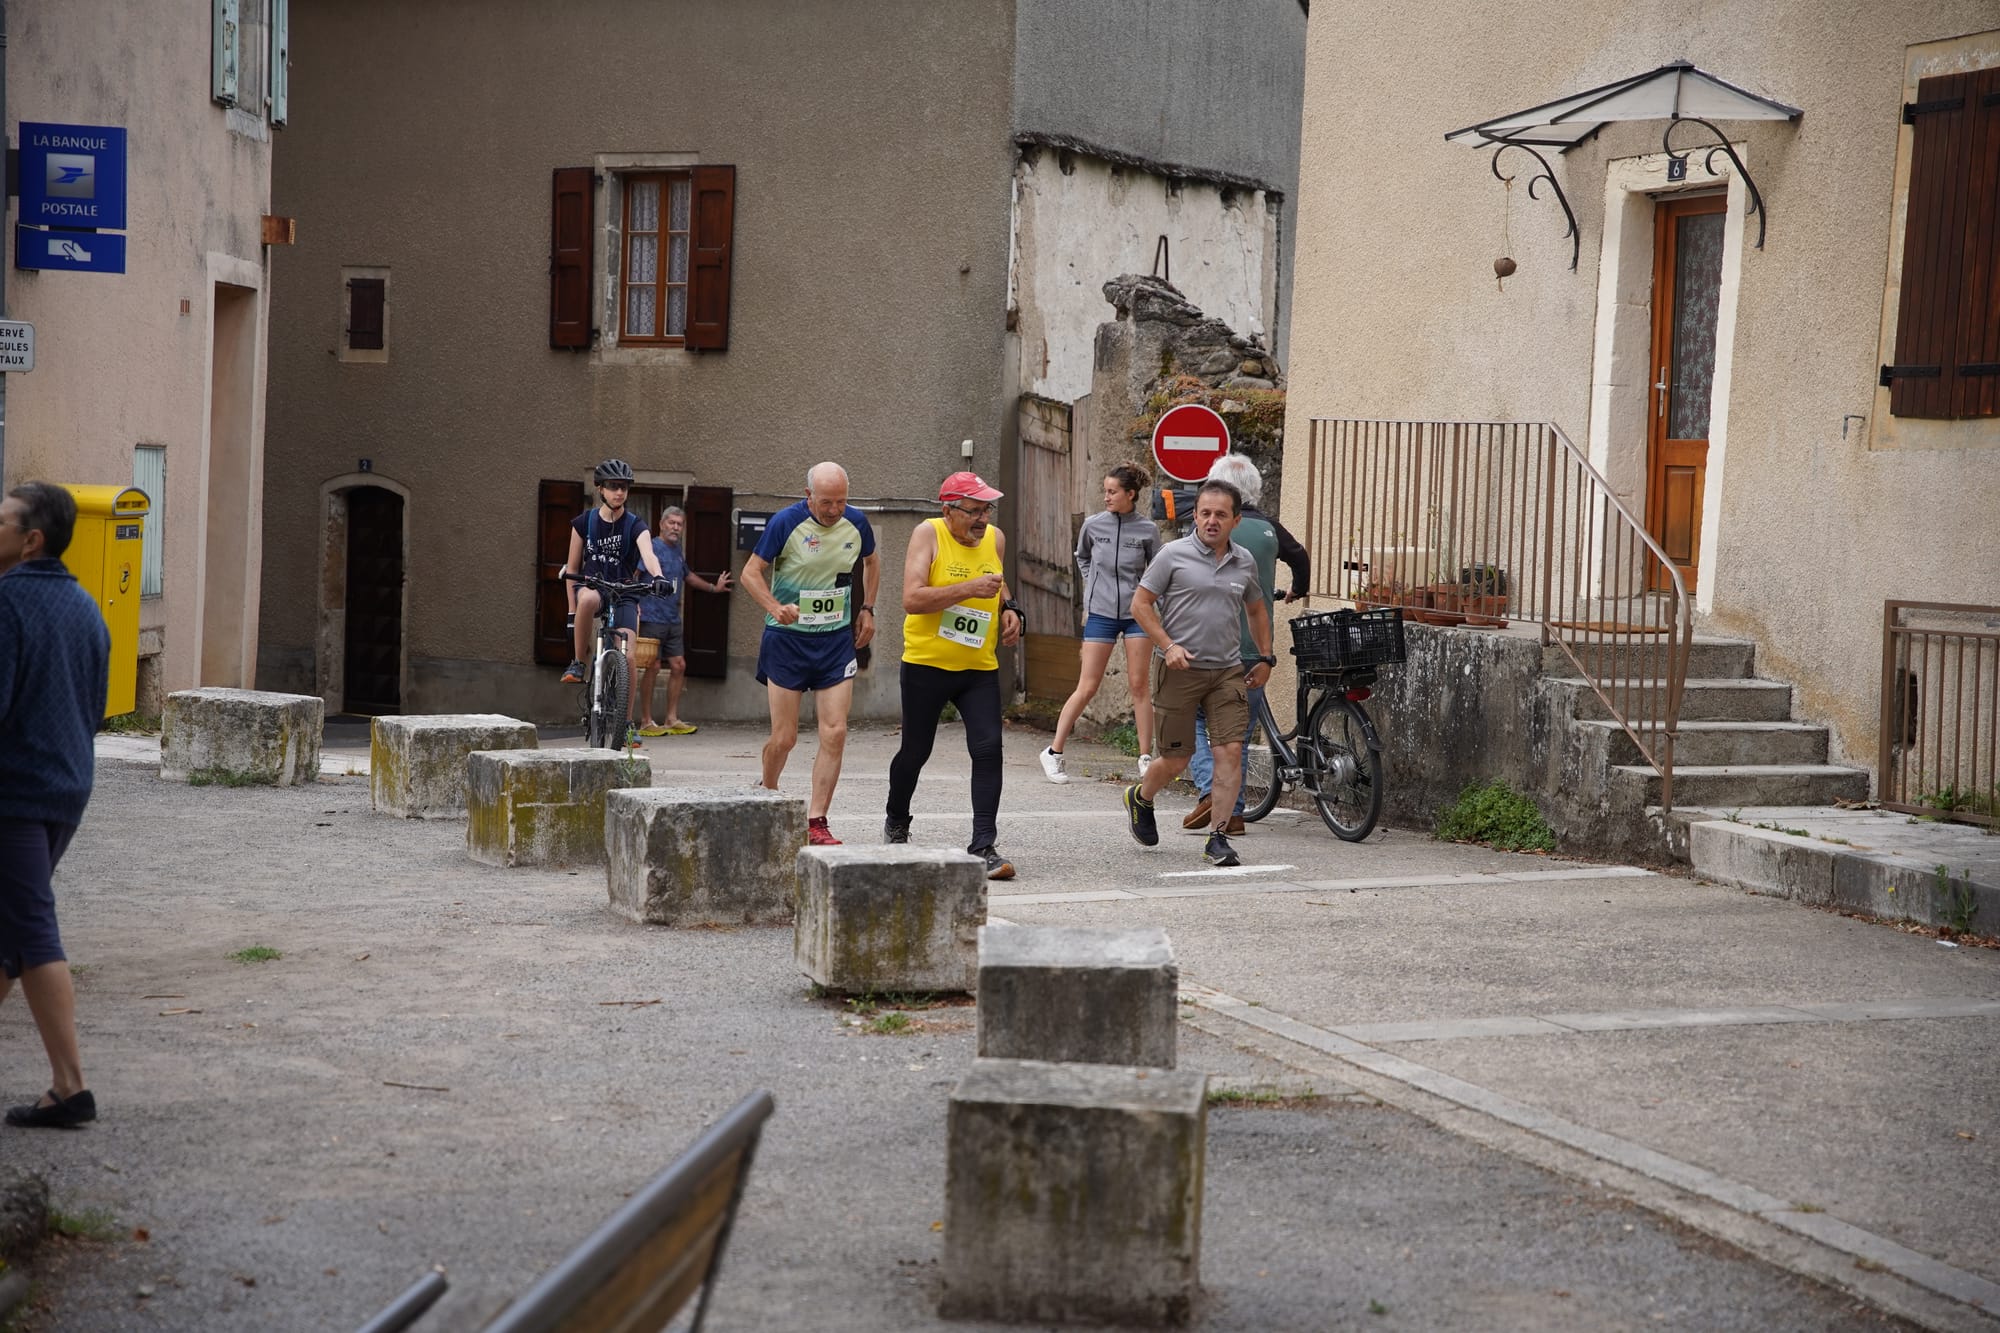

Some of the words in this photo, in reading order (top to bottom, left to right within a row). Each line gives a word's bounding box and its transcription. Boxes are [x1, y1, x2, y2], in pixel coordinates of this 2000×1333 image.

[33, 135, 49, 146] LA
[52, 136, 107, 150] BANQUE
[1673, 161, 1680, 177] 6
[41, 203, 98, 217] POSTALE
[812, 599, 834, 613] 90
[954, 616, 978, 634] 60
